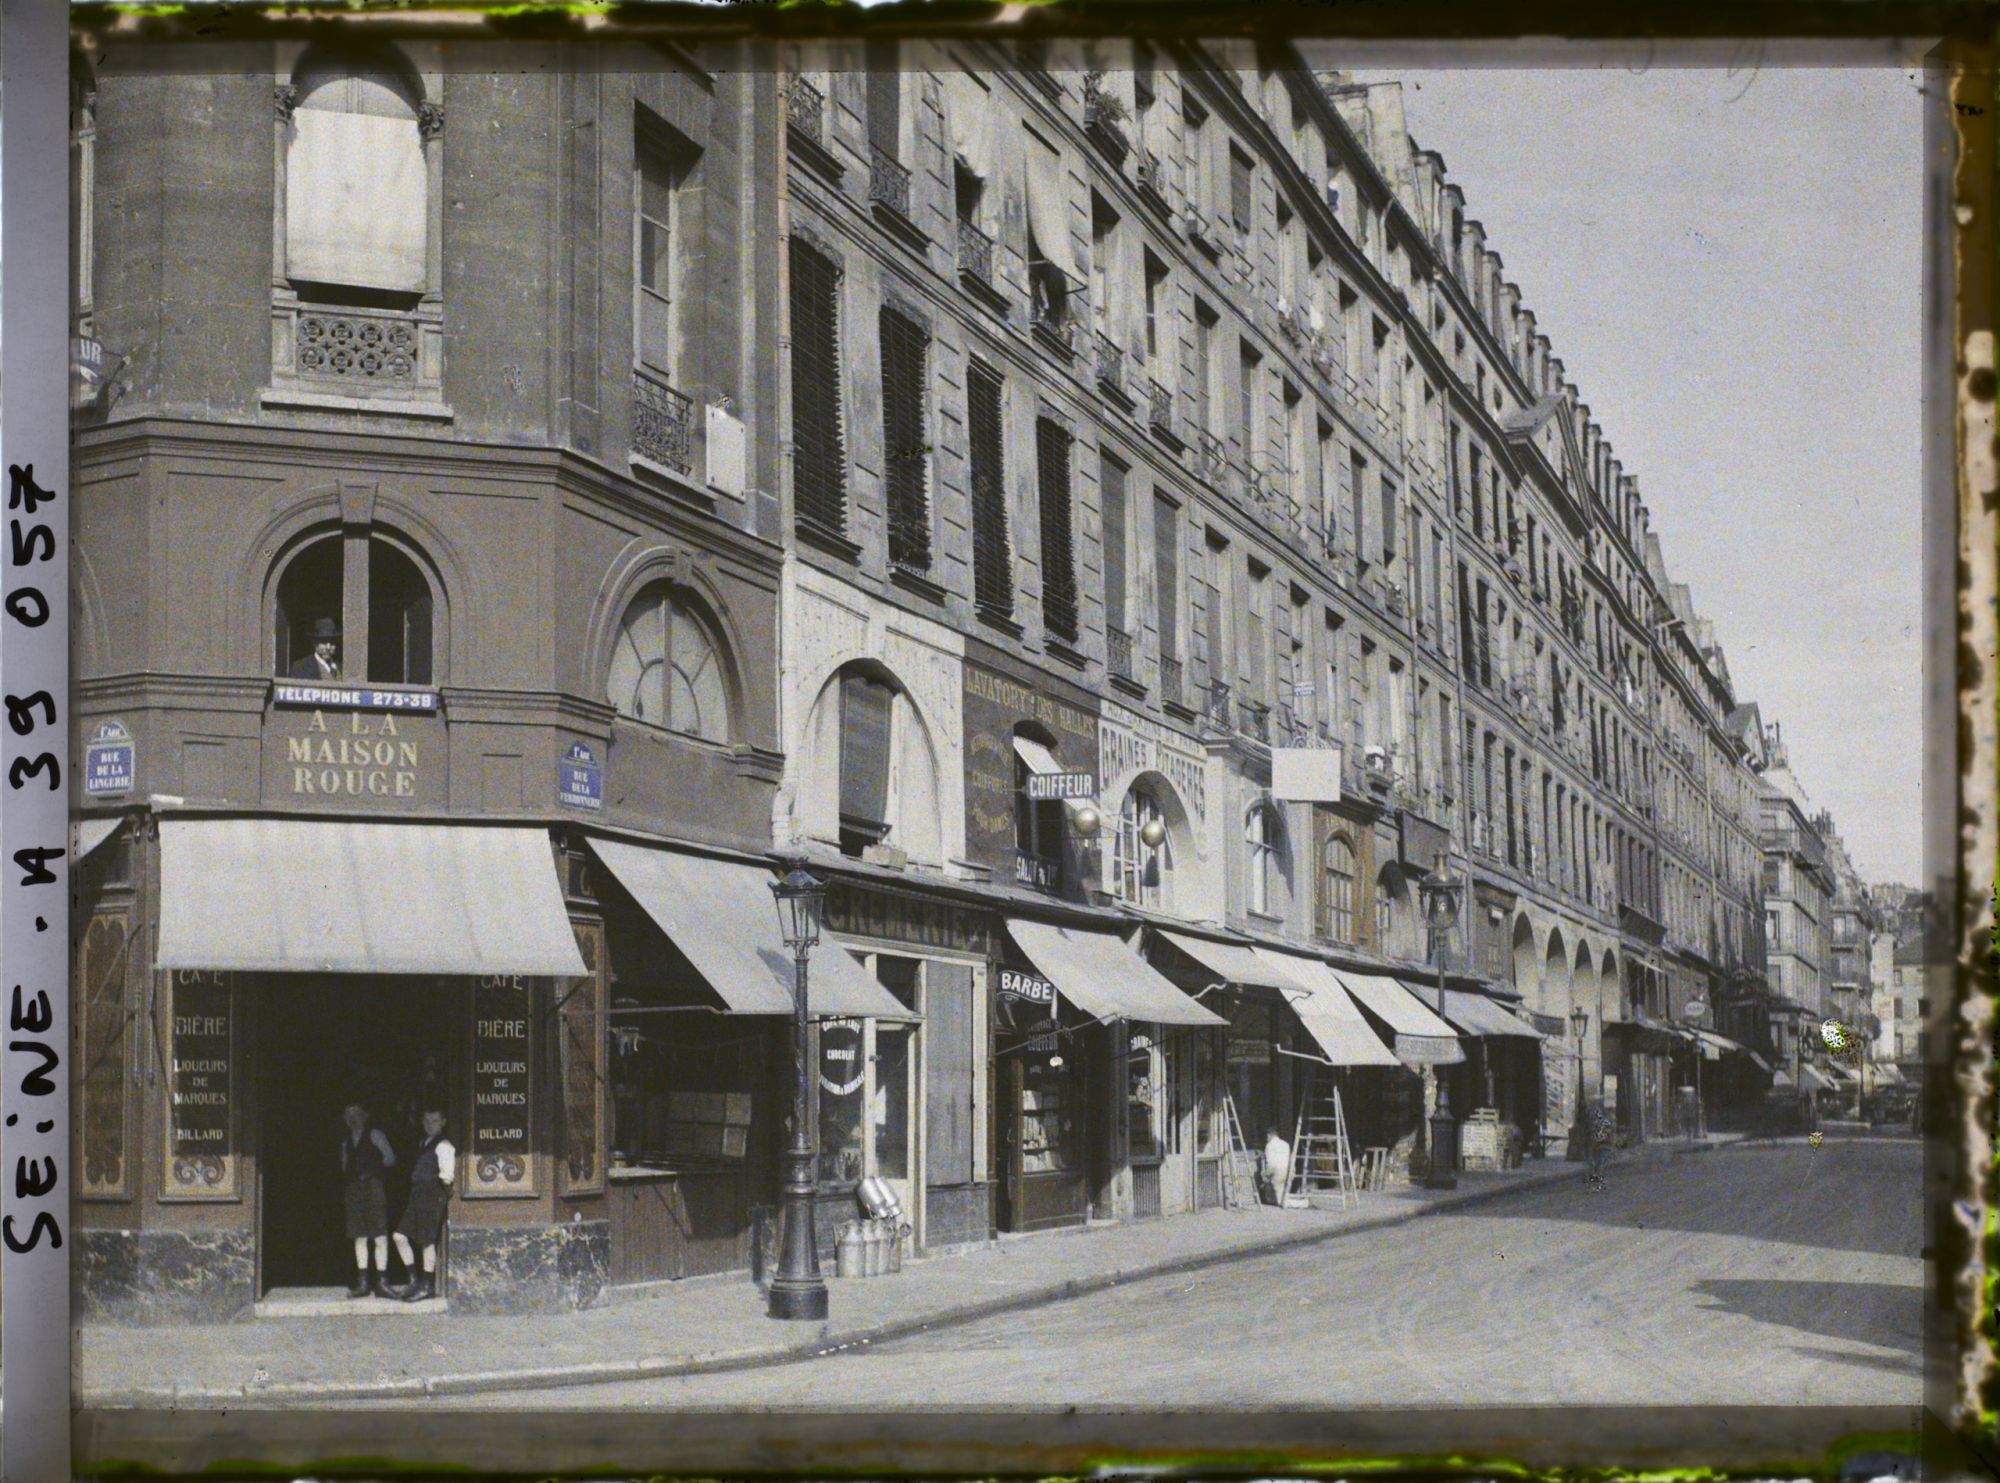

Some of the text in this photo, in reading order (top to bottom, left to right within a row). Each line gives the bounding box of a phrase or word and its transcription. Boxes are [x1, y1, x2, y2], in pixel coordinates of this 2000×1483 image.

[6, 464, 55, 627] 057
[277, 687, 361, 705] TELEPHONE
[308, 709, 328, 733] A
[5, 691, 60, 791] 39
[101, 751, 120, 763] RUE
[287, 736, 418, 767] MAISON
[1101, 727, 1147, 790] GRAINES
[97, 764, 123, 777] DE LA
[294, 767, 416, 797] ROUGE
[1029, 774, 1093, 798] COIFFEUR
[1001, 972, 1053, 1000] BARBE
[827, 1049, 856, 1061] CHOCOLAT
[174, 1058, 228, 1073] LIQUEURS
[476, 1060, 527, 1074] LIQUEURS
[192, 1076, 209, 1088] DE
[493, 1077, 509, 1088] DE
[174, 1091, 227, 1106] MARQUES
[476, 1092, 526, 1105] MARQUES
[177, 1128, 224, 1141] BILLARD
[479, 1127, 523, 1140] BILLARD
